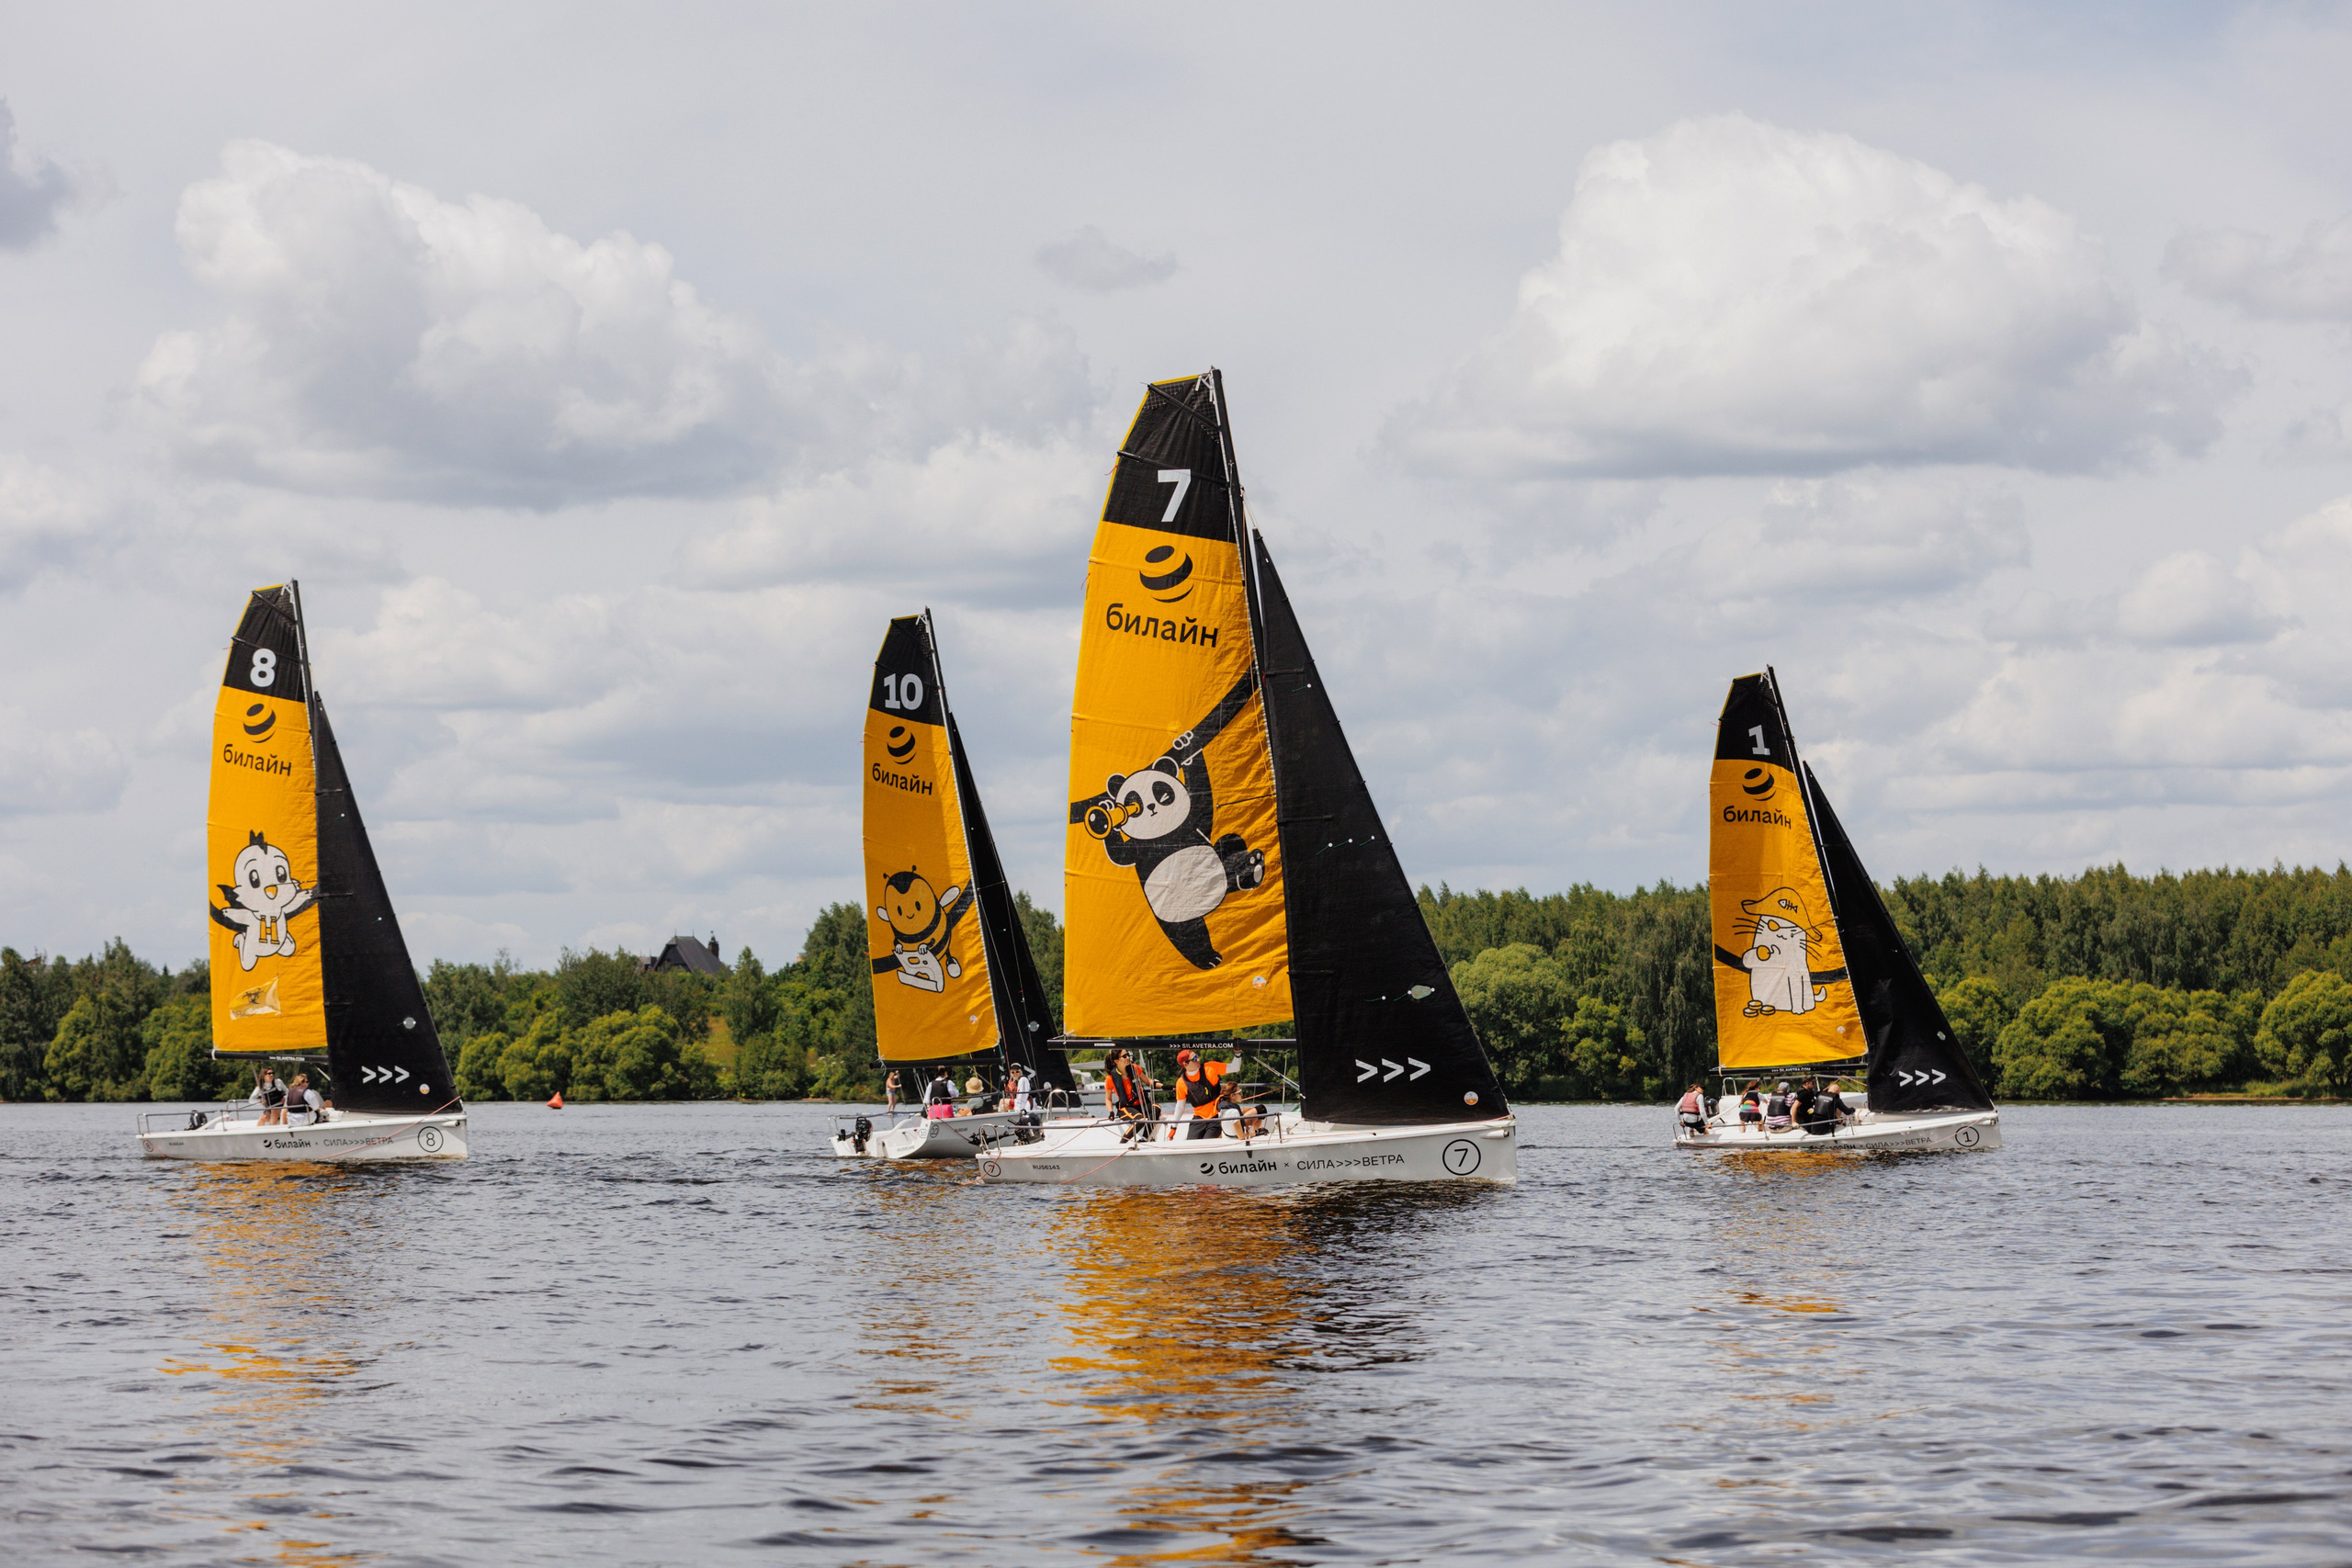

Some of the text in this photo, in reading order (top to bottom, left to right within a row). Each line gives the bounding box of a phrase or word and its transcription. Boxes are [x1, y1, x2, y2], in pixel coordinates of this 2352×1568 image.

[1158, 468, 1192, 523] 7
[1105, 603, 1219, 649] билайн
[250, 648, 277, 688] 8
[883, 672, 924, 711] 10
[1747, 724, 1771, 756] 1
[223, 743, 293, 777] билайн
[872, 762, 933, 796] билайн
[1723, 805, 1792, 830] билайн
[274, 1137, 312, 1150] билайн
[425, 1132, 435, 1146] 8
[1964, 1130, 1973, 1143] 1
[988, 1164, 995, 1173] 7
[1218, 1156, 1277, 1175] билайн
[1455, 1147, 1470, 1168] 7
